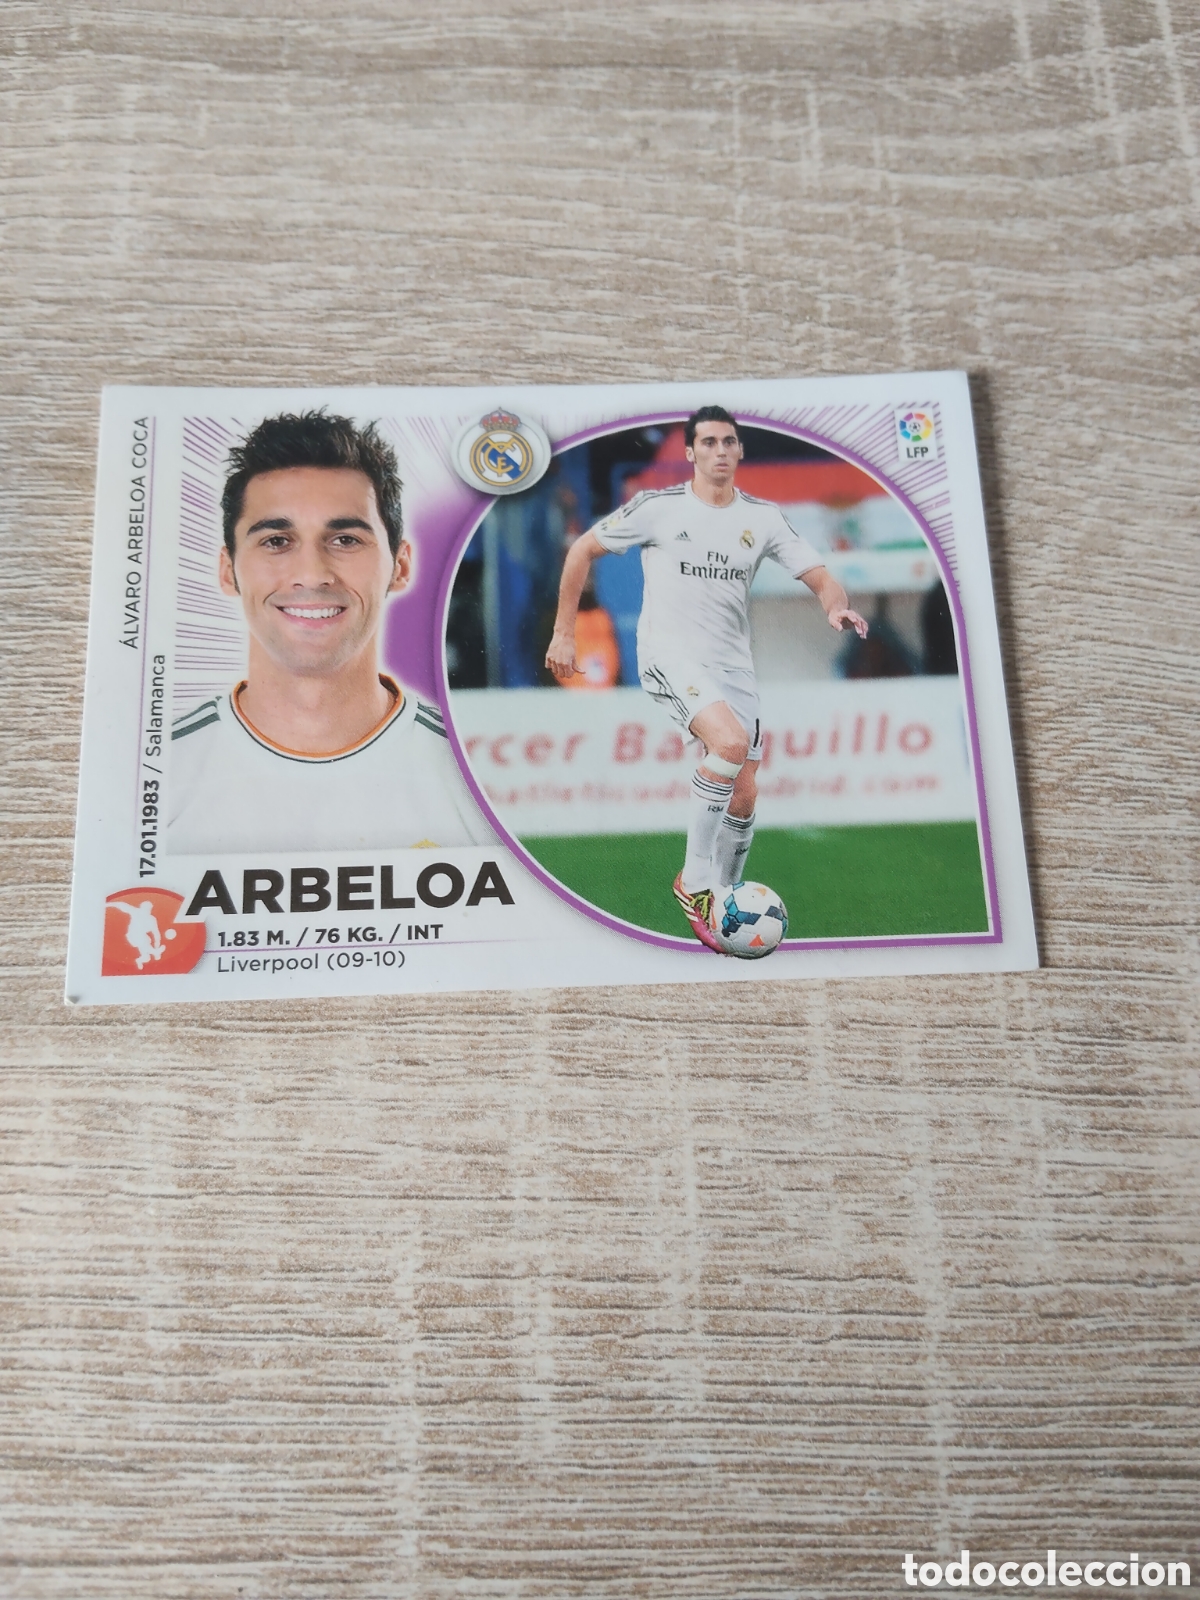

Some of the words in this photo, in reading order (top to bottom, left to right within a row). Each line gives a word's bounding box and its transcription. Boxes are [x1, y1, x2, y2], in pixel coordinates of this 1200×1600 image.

[132, 416, 149, 469] COCA
[906, 446, 929, 459] LFP
[127, 475, 146, 565] ARBELOA
[680, 561, 747, 581] Emirates
[706, 551, 729, 565] Fly
[119, 571, 142, 650] ÁLVARO
[145, 654, 165, 757] Salamanca
[143, 763, 163, 774] /
[139, 779, 160, 878] 17.01.1983
[185, 861, 516, 916] ARBELOA
[217, 930, 260, 947] 1.83
[266, 929, 291, 946] M.
[295, 927, 309, 947] /
[314, 928, 341, 944] 76
[347, 926, 384, 943] KG.
[388, 923, 401, 944] /
[407, 923, 444, 940] INT
[217, 953, 319, 974] Liverpool
[327, 950, 406, 971] (09-10)
